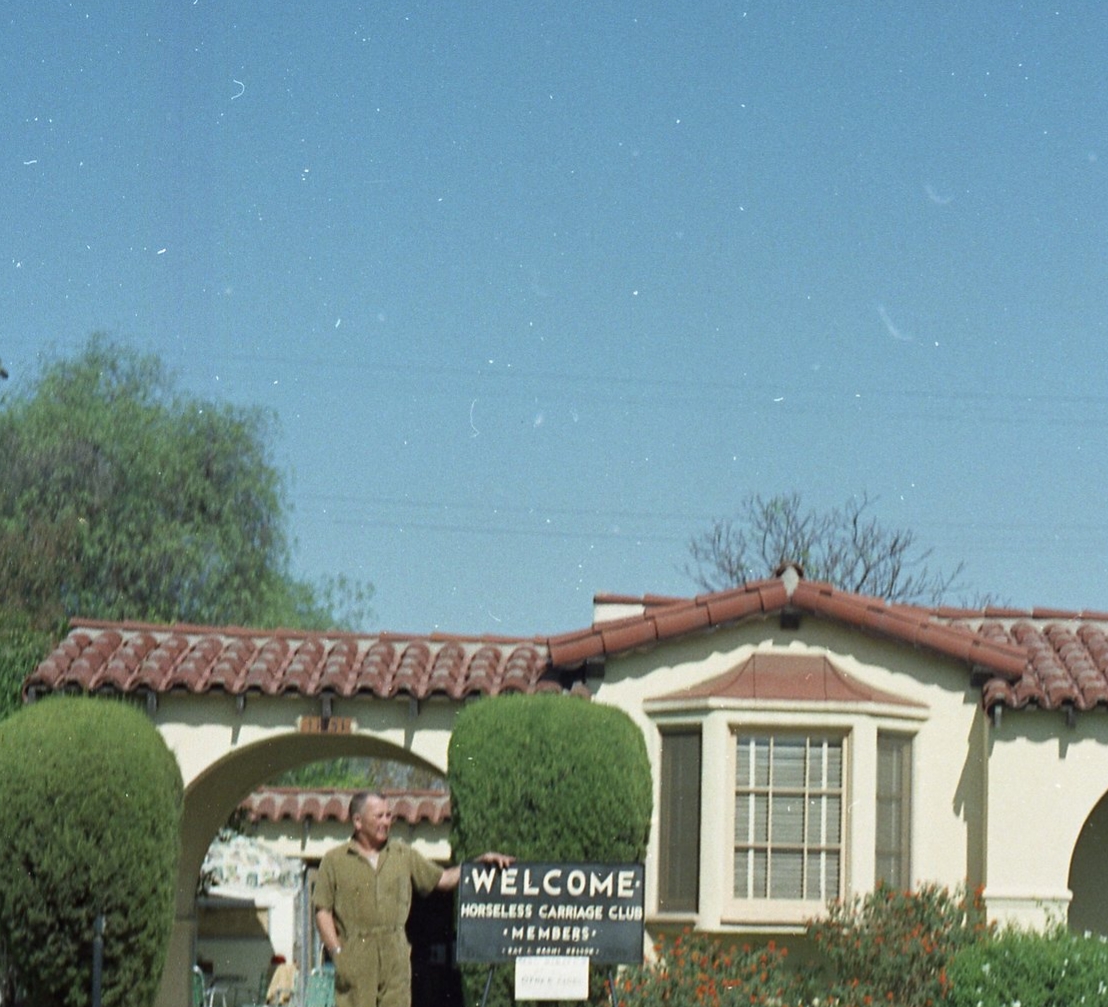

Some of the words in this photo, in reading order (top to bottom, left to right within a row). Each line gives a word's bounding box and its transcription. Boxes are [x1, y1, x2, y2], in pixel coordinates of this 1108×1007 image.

[472, 868, 635, 898] WELCOME
[461, 903, 533, 918] HORSELESS
[538, 904, 603, 920] CARRIAGE
[608, 905, 643, 921] CLUB
[511, 925, 590, 942] MEMBERS
